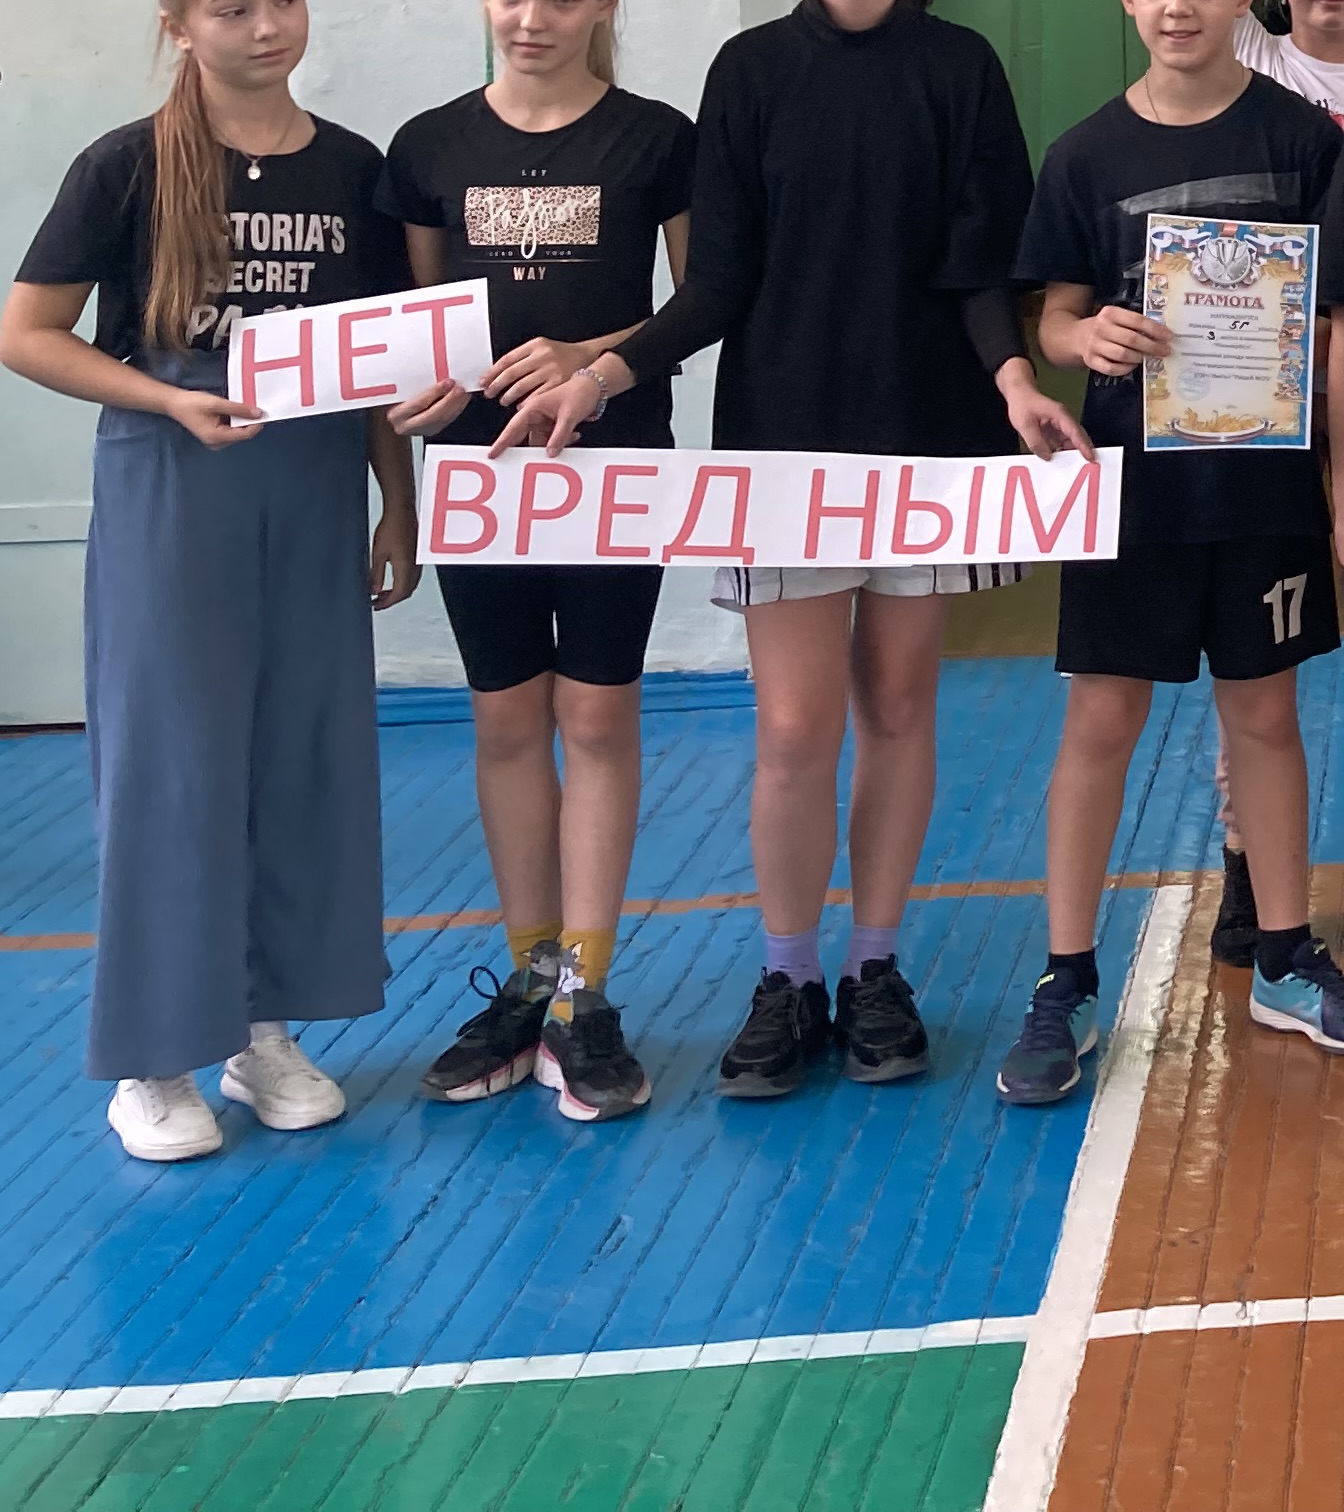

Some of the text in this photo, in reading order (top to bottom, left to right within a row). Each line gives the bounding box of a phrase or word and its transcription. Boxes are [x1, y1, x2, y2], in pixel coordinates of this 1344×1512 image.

[521, 169, 547, 177] LET
[222, 212, 346, 254] TORIA'S
[207, 260, 316, 294] ECRET
[513, 266, 546, 281] WAY
[1184, 292, 1265, 310] ГРАМОТА
[241, 295, 473, 411] НЕТ
[1263, 573, 1307, 644] 17
